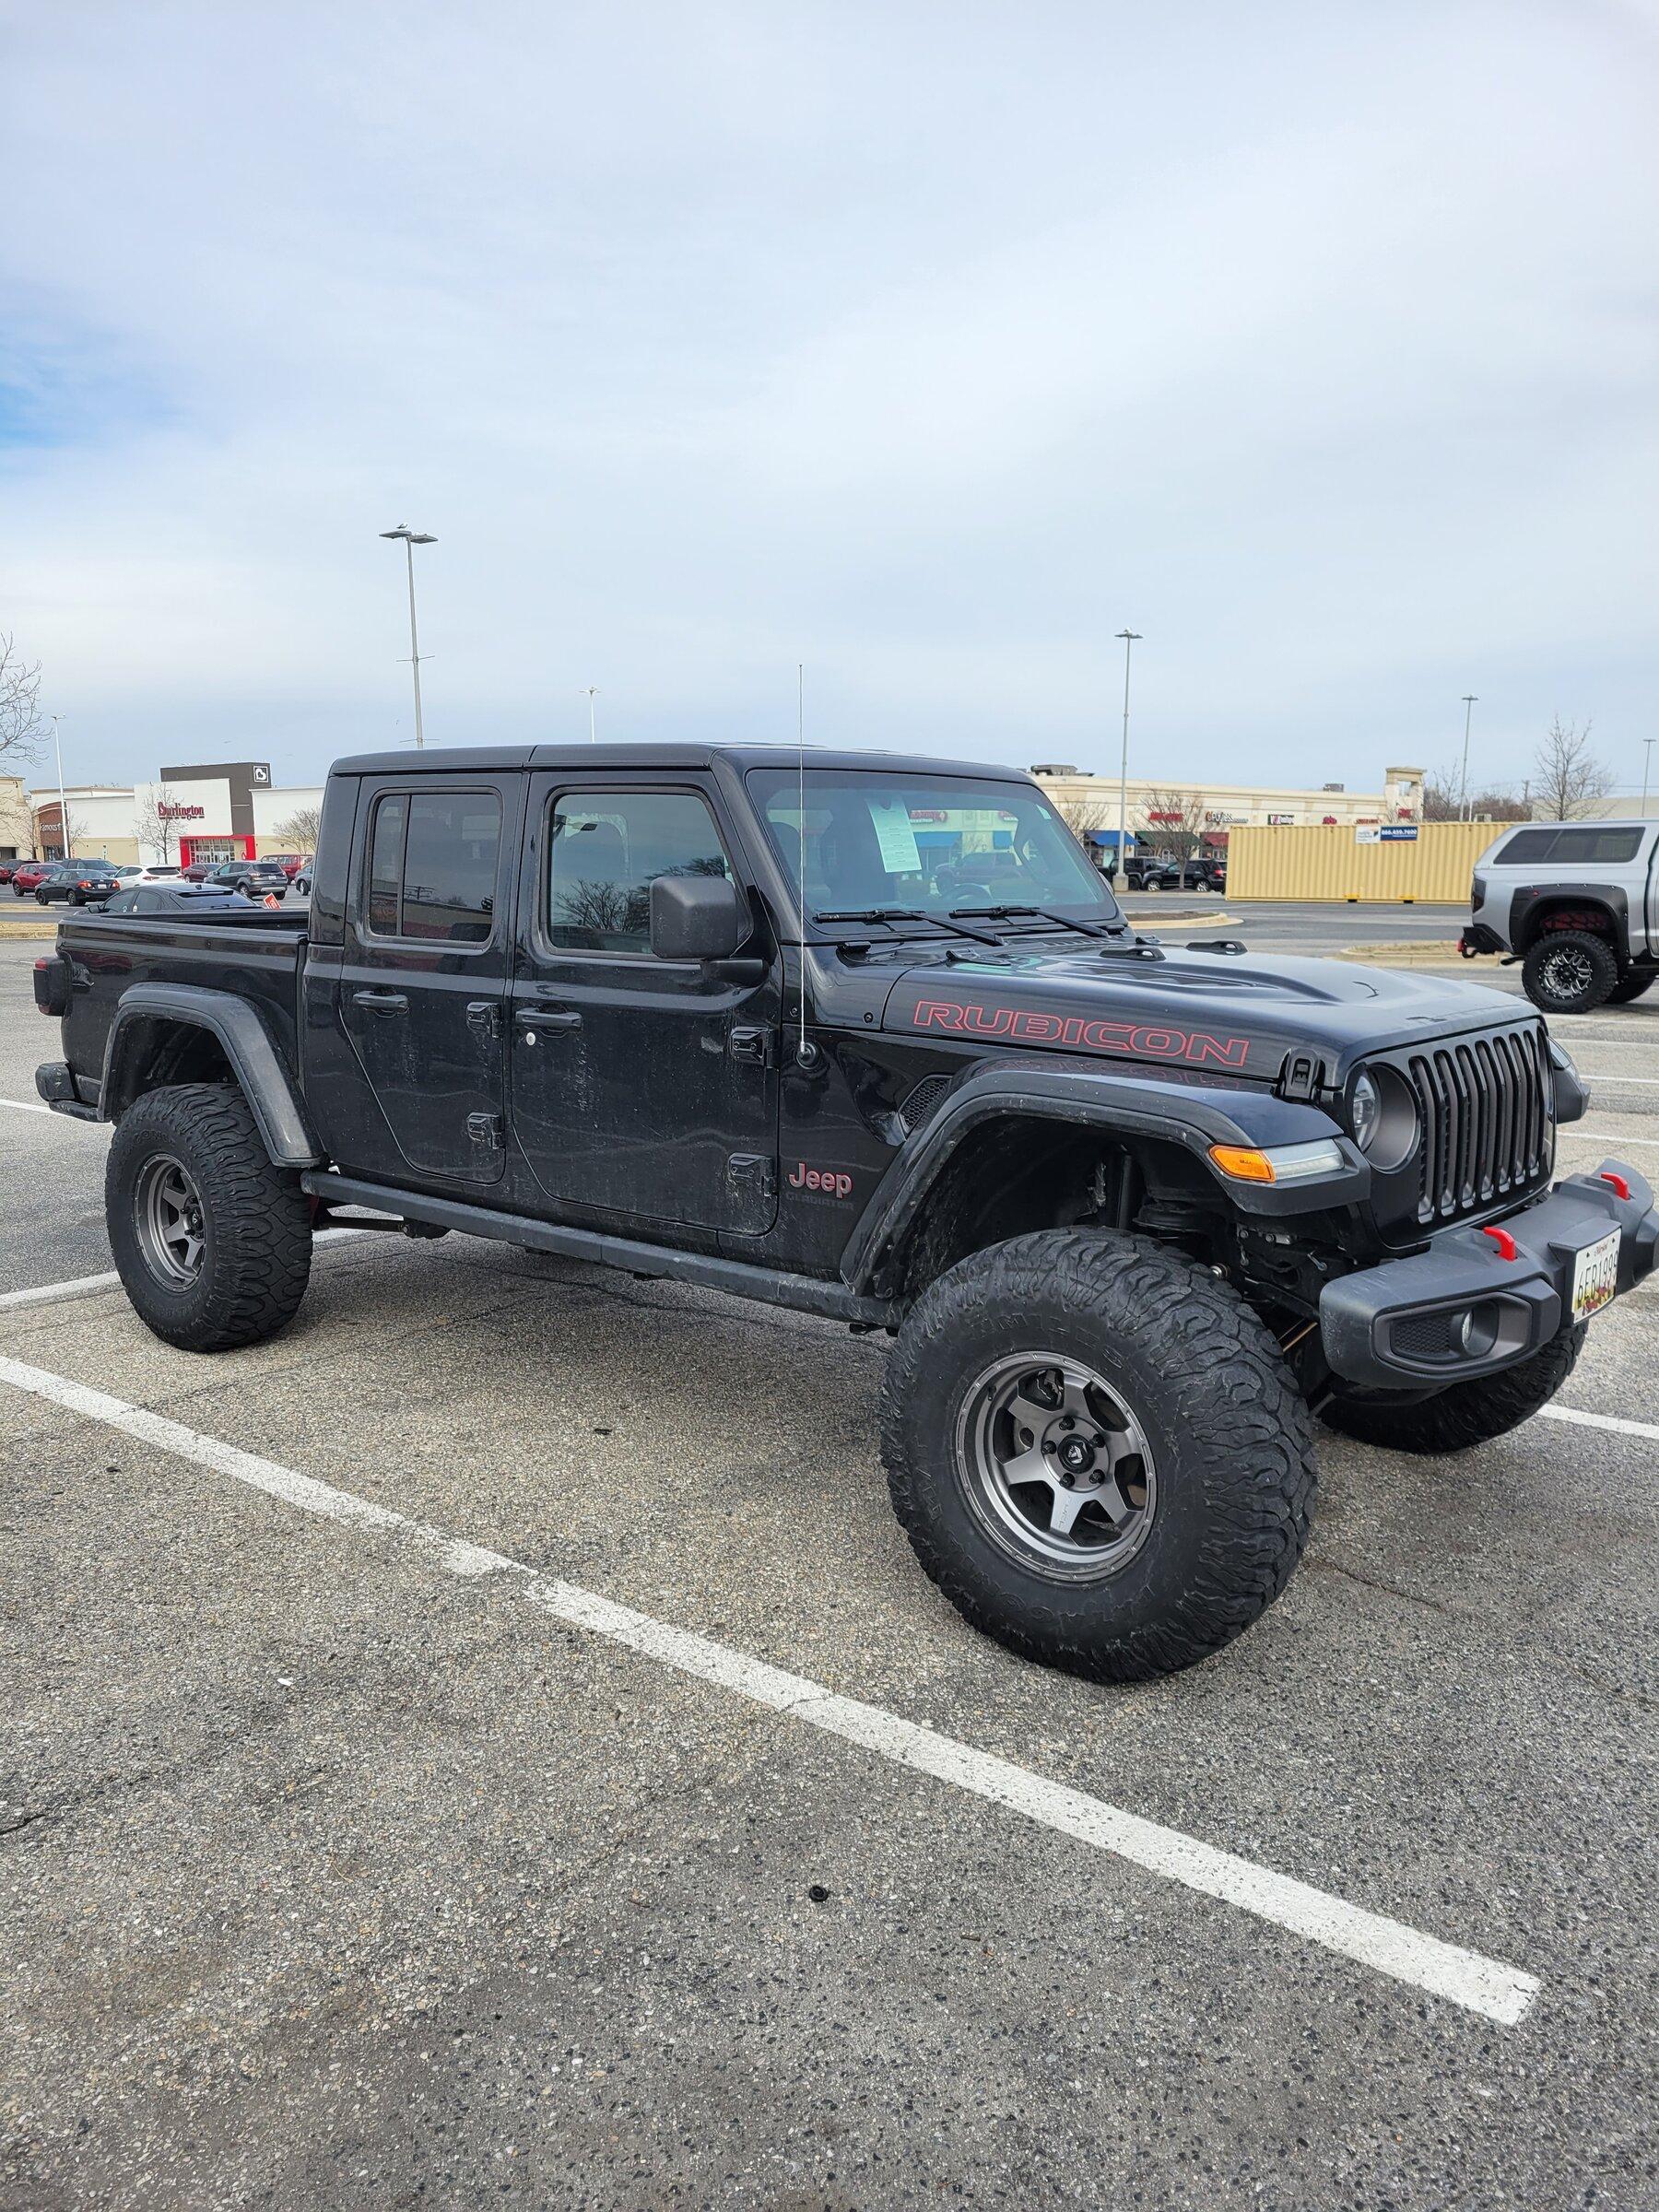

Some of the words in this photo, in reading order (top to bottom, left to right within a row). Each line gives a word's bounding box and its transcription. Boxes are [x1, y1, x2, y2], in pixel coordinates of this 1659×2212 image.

[157, 801, 205, 820] Burlington
[913, 1000, 1250, 1067] RUBICON
[788, 1162, 853, 1199] Jeep
